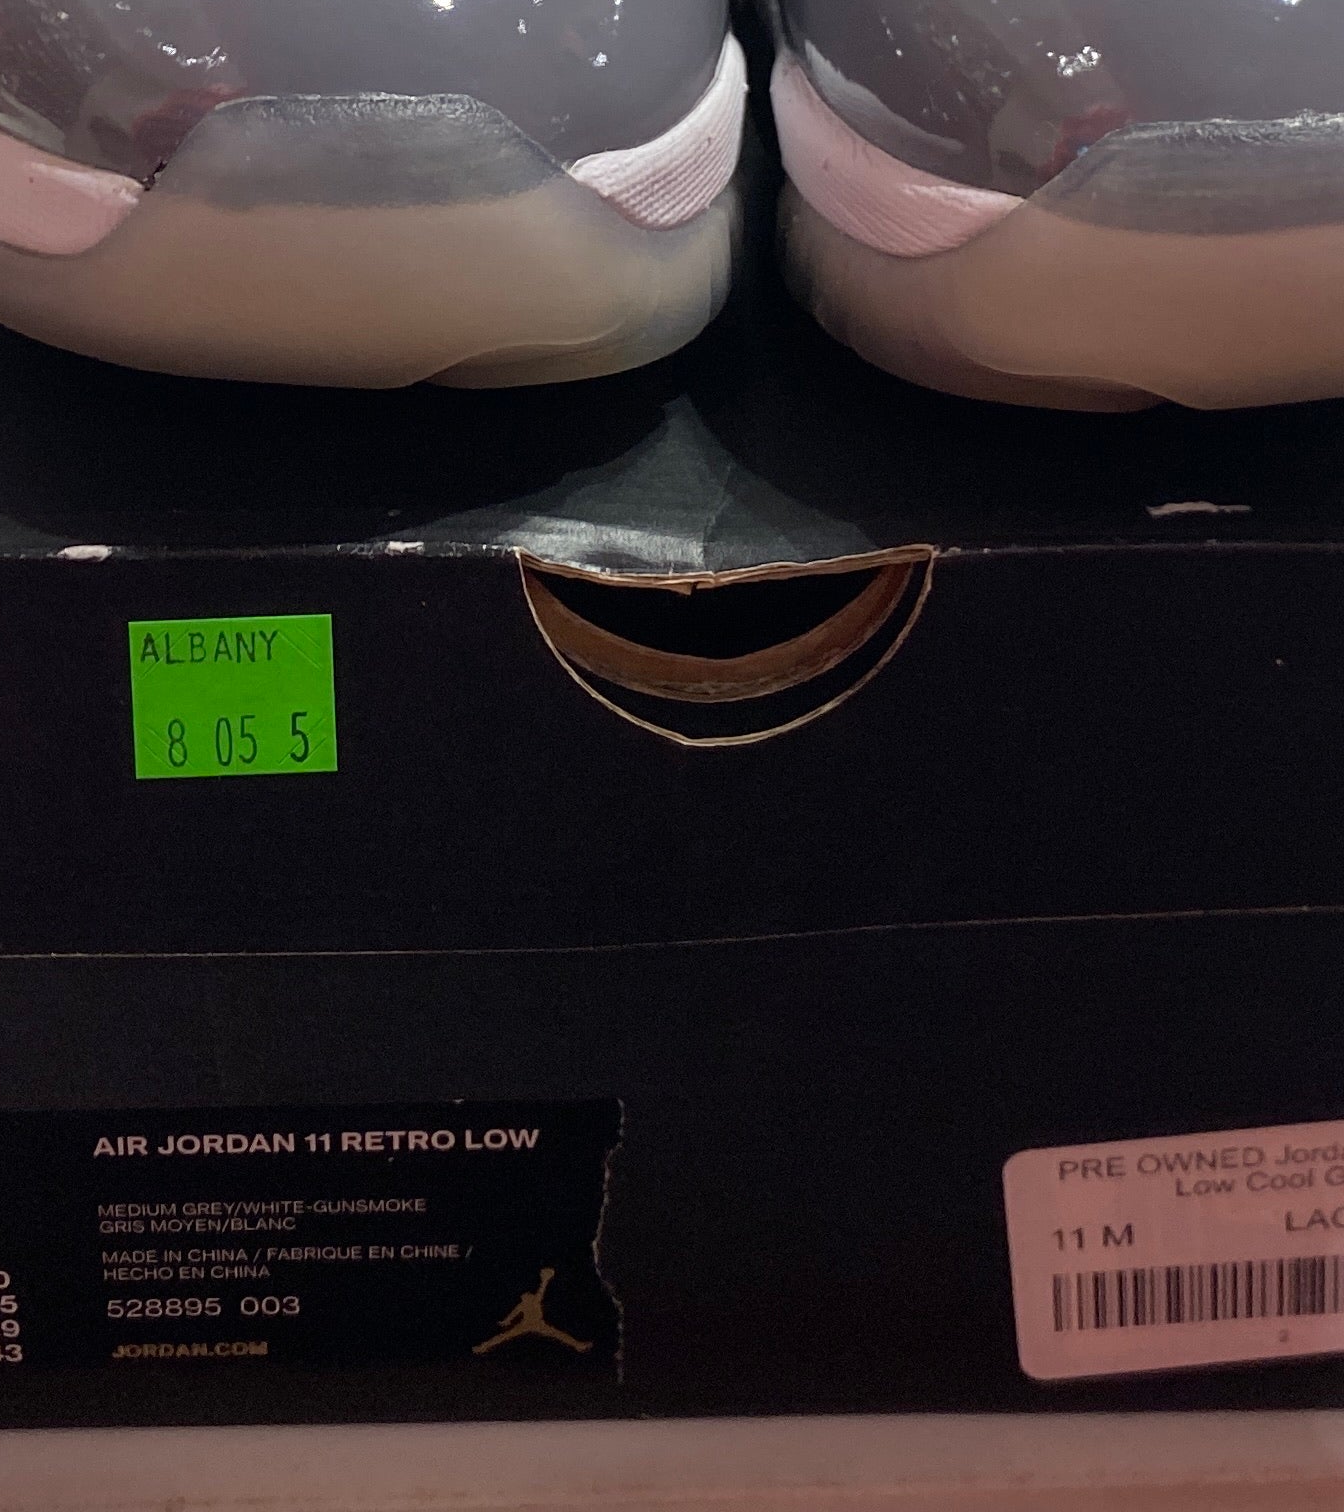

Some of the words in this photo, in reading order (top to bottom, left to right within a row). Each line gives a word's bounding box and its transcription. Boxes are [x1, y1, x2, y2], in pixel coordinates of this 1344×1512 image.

[140, 629, 279, 665] ALBANY
[166, 718, 188, 768] 8
[215, 714, 259, 768] 05
[289, 711, 310, 764] 5
[93, 1135, 148, 1158] AIR
[157, 1132, 296, 1156] JORDAN
[305, 1133, 331, 1154] 11
[341, 1129, 456, 1154] RETRO
[465, 1128, 540, 1151] LOW
[1058, 1156, 1126, 1182] PRE
[1137, 1147, 1264, 1176] OWNED
[1175, 1174, 1235, 1198] Low
[1247, 1167, 1315, 1193] Cool
[98, 1203, 177, 1219] MEDIUM
[182, 1198, 427, 1216] GREY/WHITE-GUNSMOKE
[99, 1219, 145, 1234] GRIS
[150, 1216, 297, 1234] MOYEN/BLANC
[1052, 1228, 1086, 1251] 11
[1102, 1224, 1134, 1248] M
[102, 1249, 158, 1265] MADE
[164, 1249, 183, 1264] IN
[188, 1248, 248, 1264] CHINA
[267, 1246, 364, 1263] FABRIQUE
[369, 1245, 395, 1260] EN
[400, 1244, 460, 1259] CHINE
[104, 1265, 174, 1281] HECHO
[179, 1265, 206, 1279] EN
[210, 1264, 271, 1279] CHINA
[106, 1297, 222, 1318] 528895
[240, 1296, 300, 1315] 003
[112, 1341, 268, 1359] JORDAN.COM
